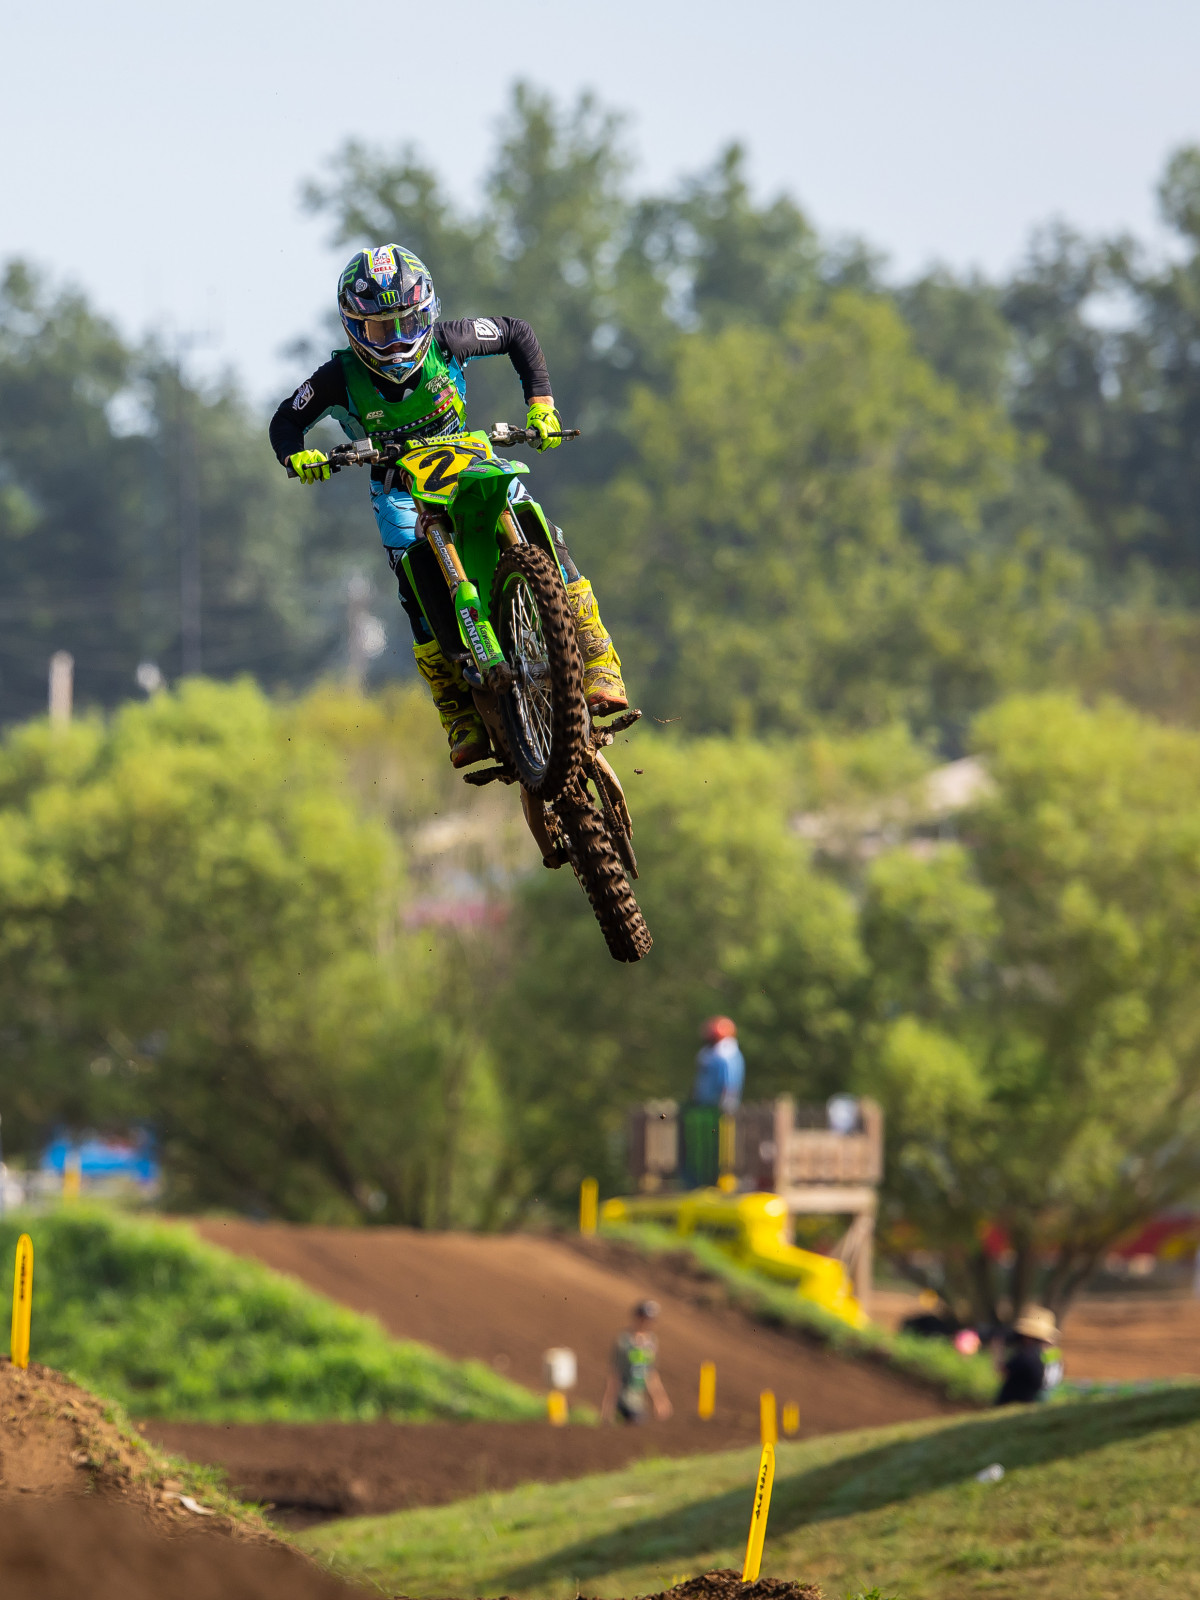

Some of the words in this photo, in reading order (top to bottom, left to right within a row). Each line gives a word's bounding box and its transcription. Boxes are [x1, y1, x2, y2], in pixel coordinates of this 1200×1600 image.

[373, 265, 393, 273] BELL
[418, 449, 459, 492] 2
[431, 529, 445, 547] PRO
[440, 547, 459, 578] CIRCUIT
[459, 607, 489, 662] DUNLOP
